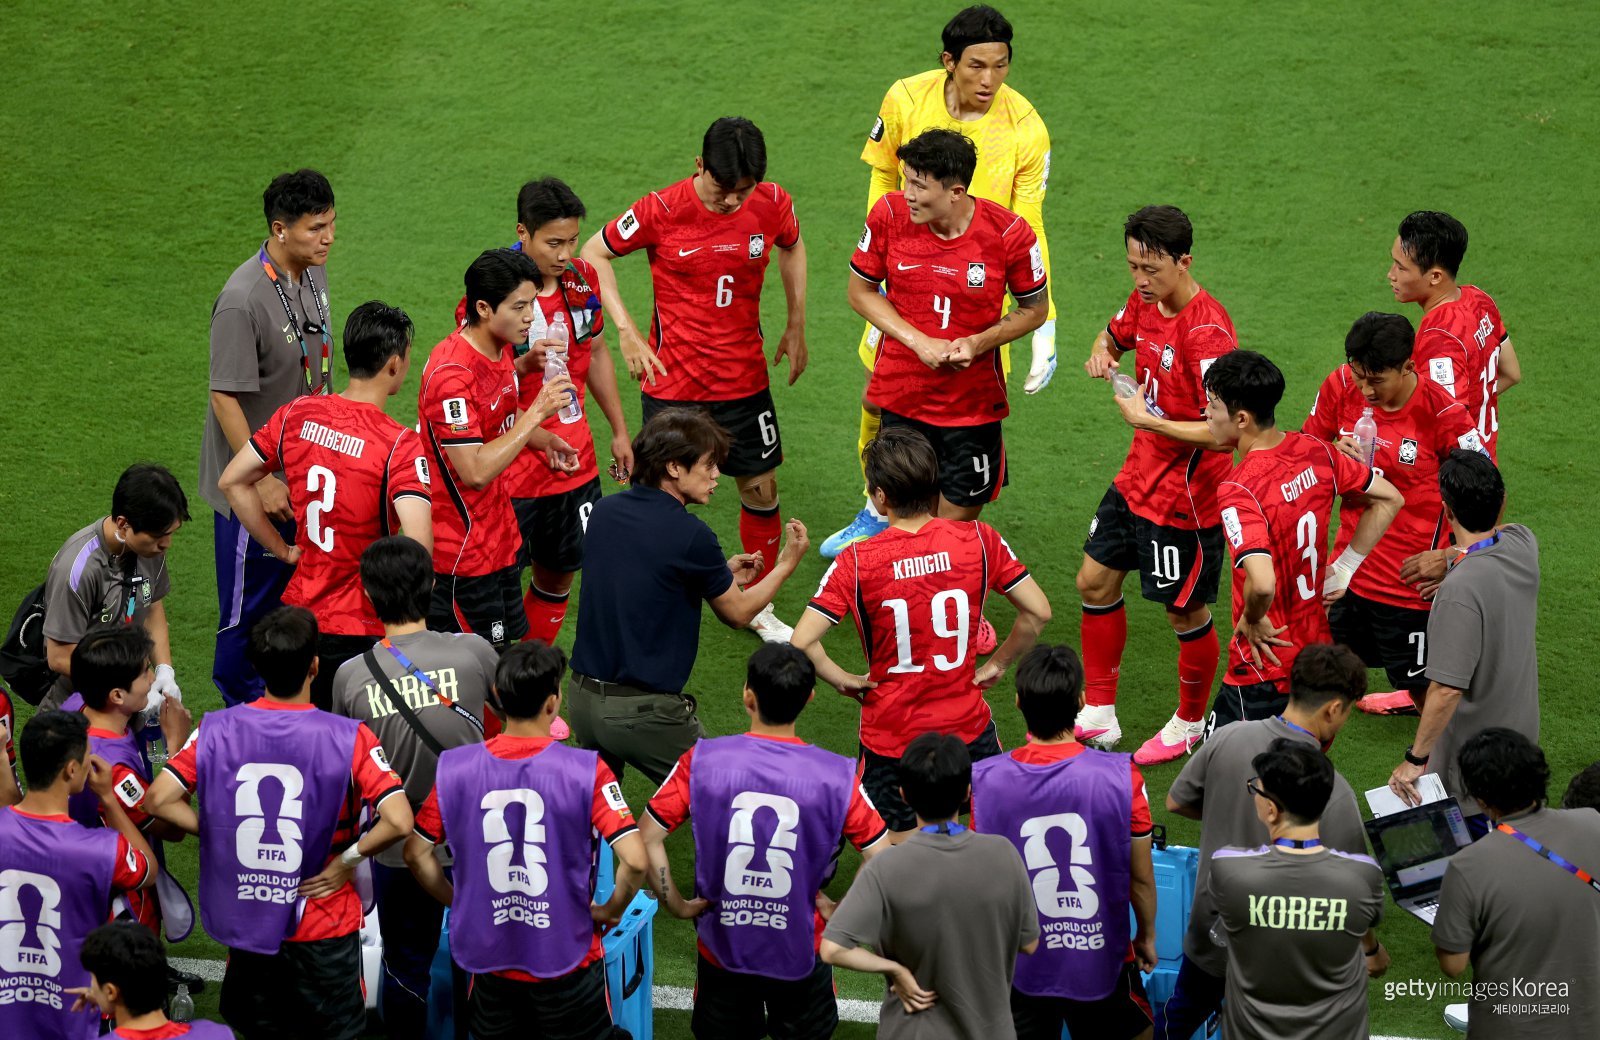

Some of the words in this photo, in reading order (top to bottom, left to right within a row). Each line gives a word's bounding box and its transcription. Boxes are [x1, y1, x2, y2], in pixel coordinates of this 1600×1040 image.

[715, 274, 735, 308] 6
[933, 294, 951, 330] 4
[299, 419, 366, 459] HANBEOM
[757, 410, 777, 446] 6
[972, 453, 990, 487] 4
[305, 464, 337, 553] 2
[892, 551, 952, 581] KANGIN
[1150, 539, 1181, 582] 10
[1295, 510, 1319, 600] 3
[881, 588, 971, 675] 19
[1408, 631, 1425, 666] 7
[257, 848, 287, 863] FIFA
[237, 873, 280, 886] WORLD
[508, 870, 531, 887] FIFA
[741, 874, 774, 889] FIFA
[237, 884, 299, 905] 2026
[491, 895, 528, 909] WORLD
[528, 900, 550, 912] CUP
[1056, 896, 1083, 910] FIFA
[493, 906, 551, 929] 2026
[721, 899, 764, 910] WORLD
[764, 901, 790, 914] CUP
[1249, 895, 1348, 931] KOREA
[719, 909, 788, 930] 2026
[1042, 921, 1081, 933] WORLD
[1080, 921, 1103, 934] CUP
[1045, 932, 1106, 951] 2026
[17, 952, 48, 967] FIFA
[0, 975, 43, 988] WORLD
[44, 979, 63, 993] CUP
[0, 986, 63, 1010] 2026
